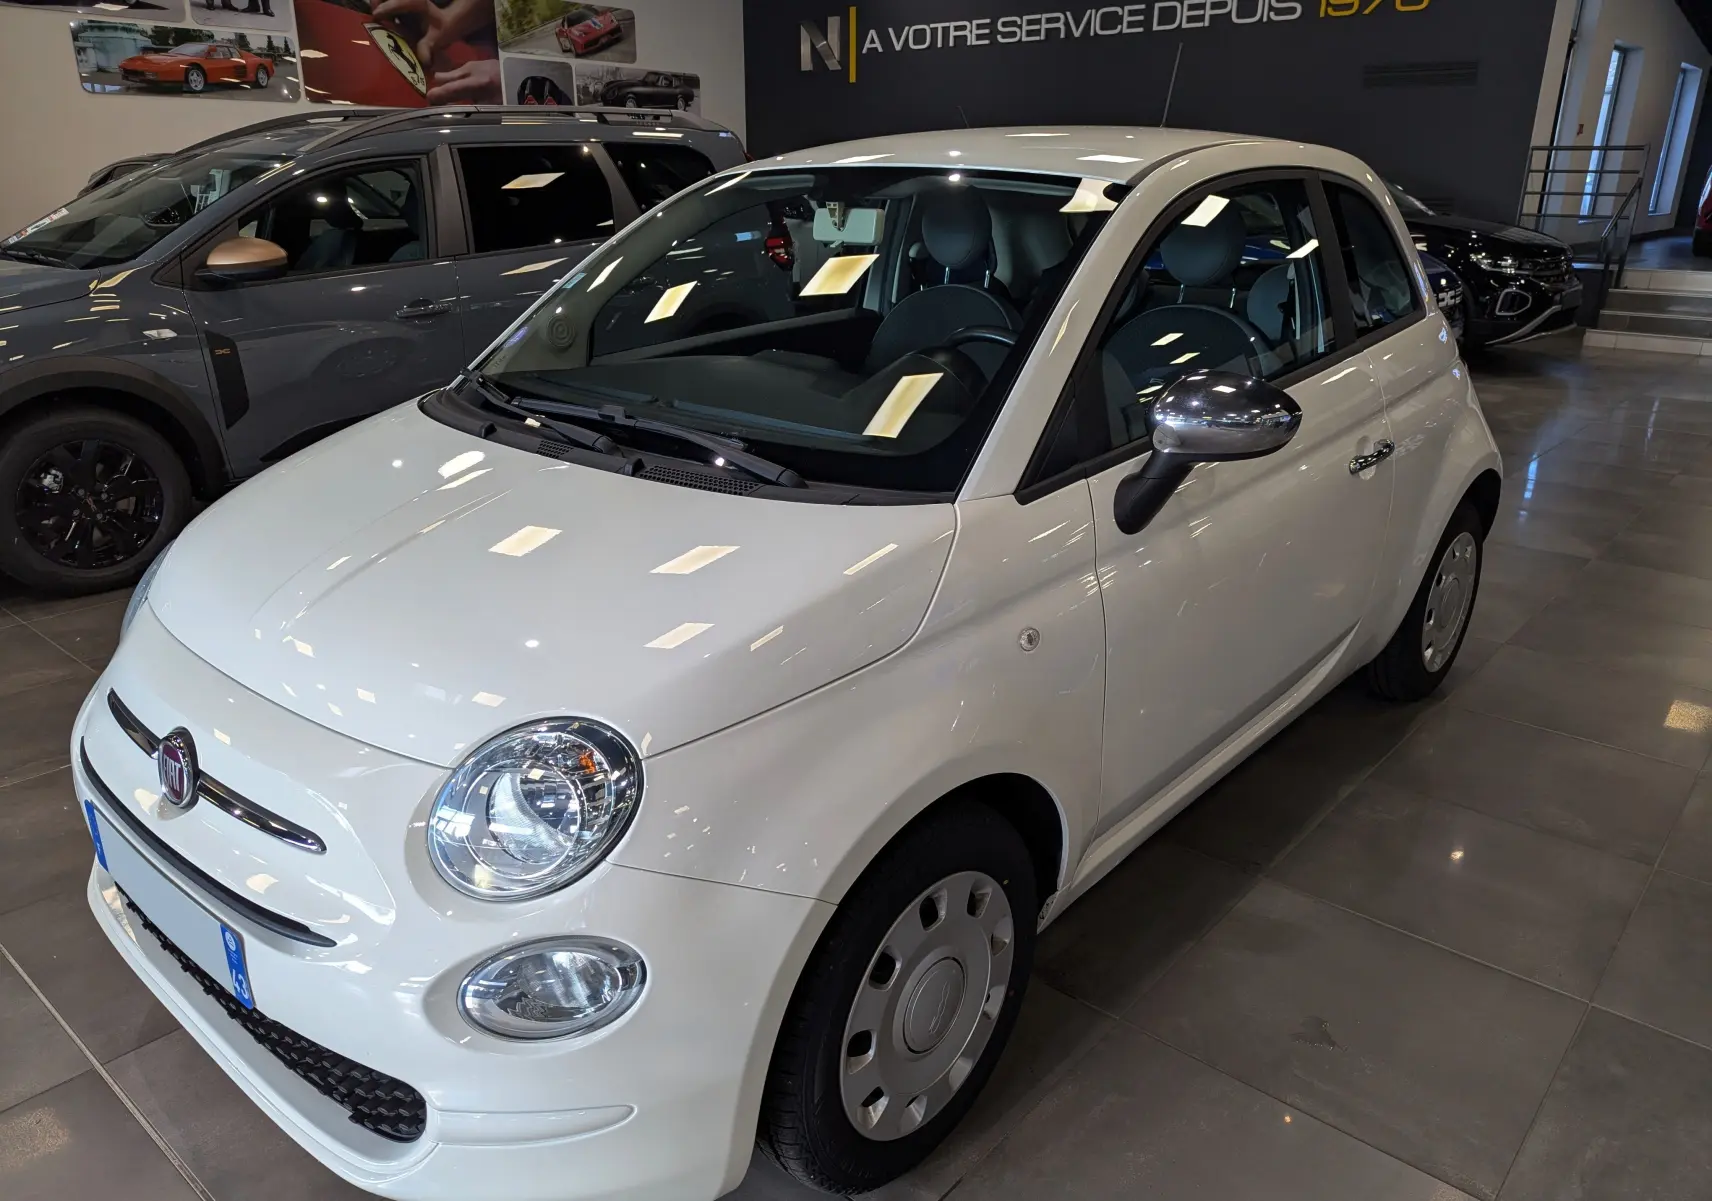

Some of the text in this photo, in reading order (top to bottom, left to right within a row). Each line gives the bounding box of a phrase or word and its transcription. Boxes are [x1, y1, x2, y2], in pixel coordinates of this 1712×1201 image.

[862, 29, 884, 54] A
[888, 18, 991, 51] VOTRE
[997, 5, 1146, 43] SERVICE
[1152, 0, 1303, 31] DEPUIS
[163, 753, 181, 792] FIAT
[232, 968, 250, 1000] 43
